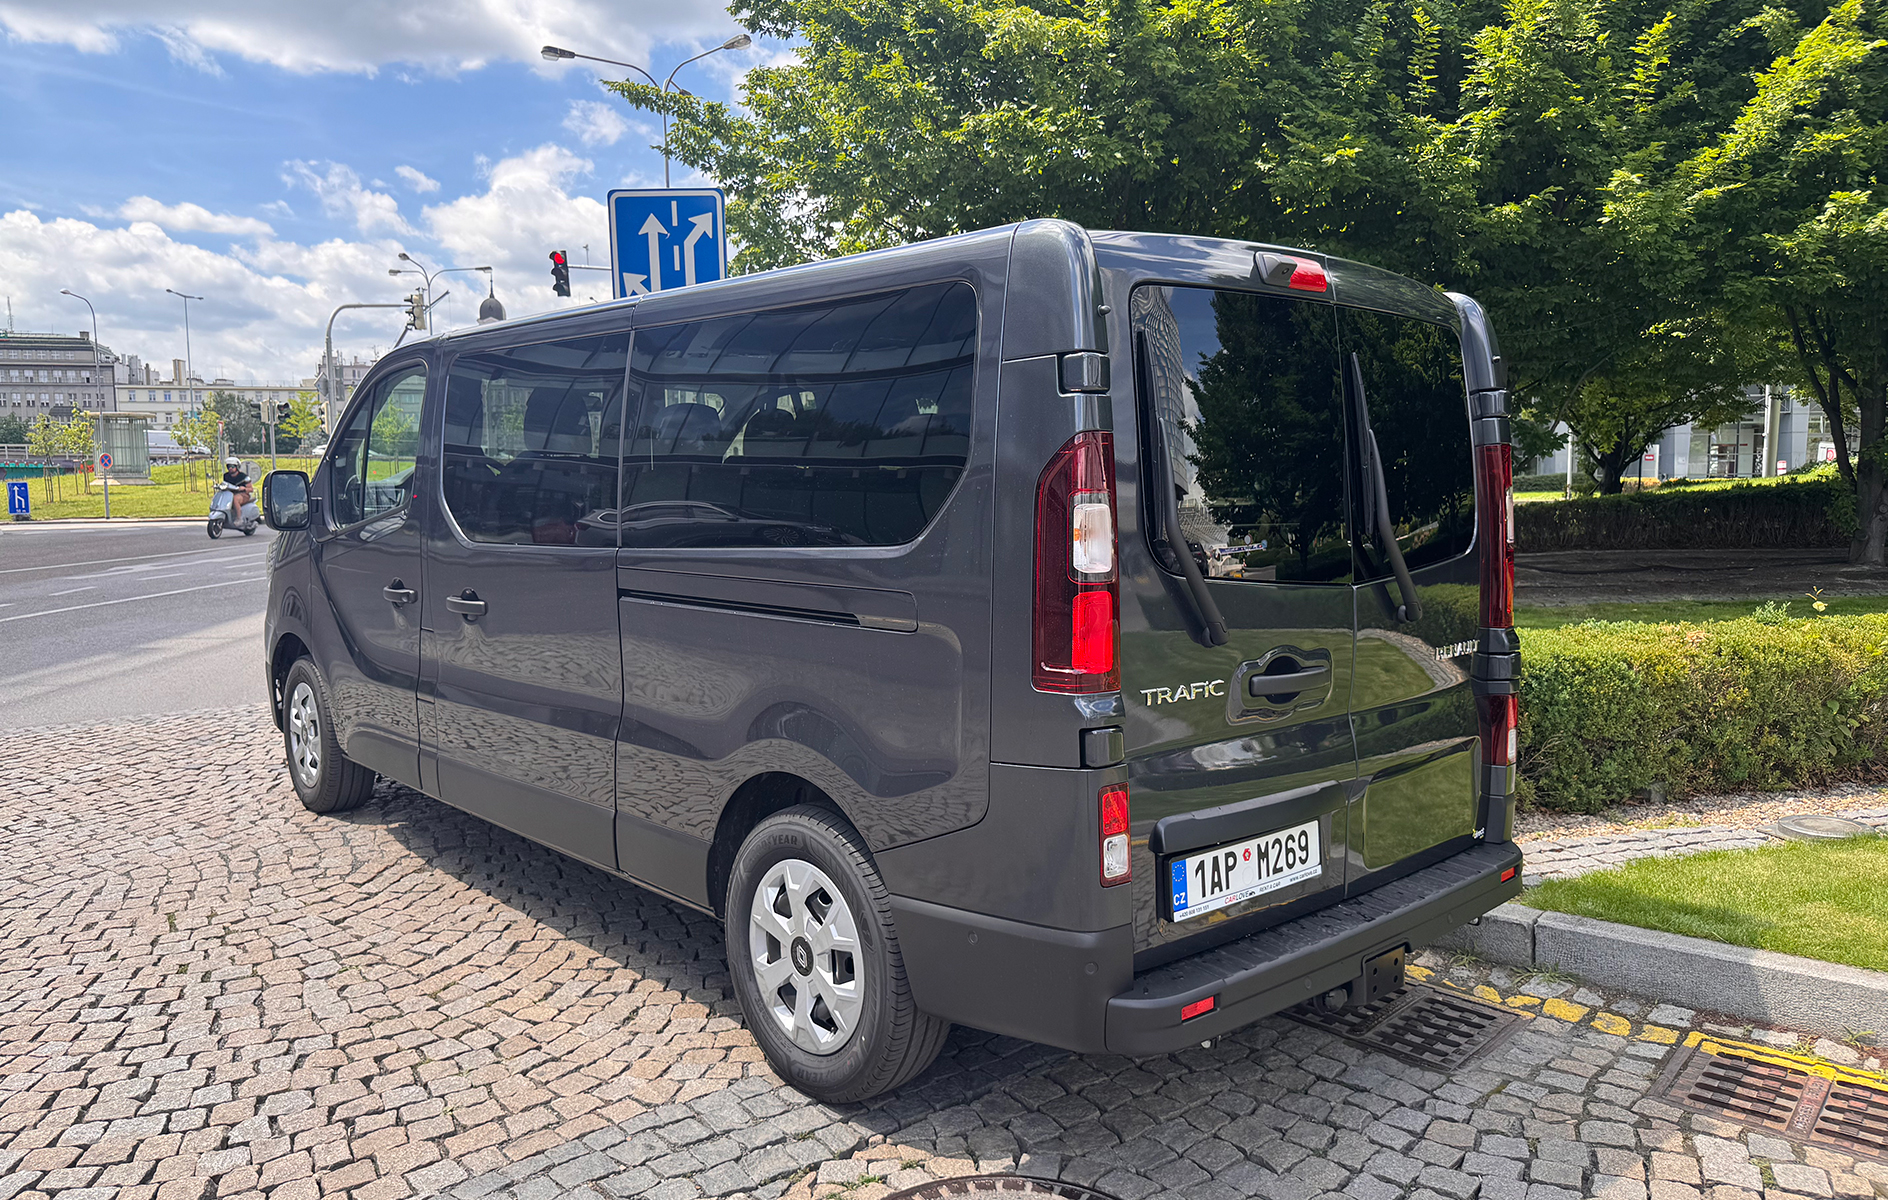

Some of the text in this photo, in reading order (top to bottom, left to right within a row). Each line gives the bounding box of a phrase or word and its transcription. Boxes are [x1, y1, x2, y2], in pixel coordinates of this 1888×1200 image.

[1195, 830, 1309, 898] 1AP M269
[1173, 892, 1186, 906] CZ
[1224, 890, 1250, 904] CARLOVE
